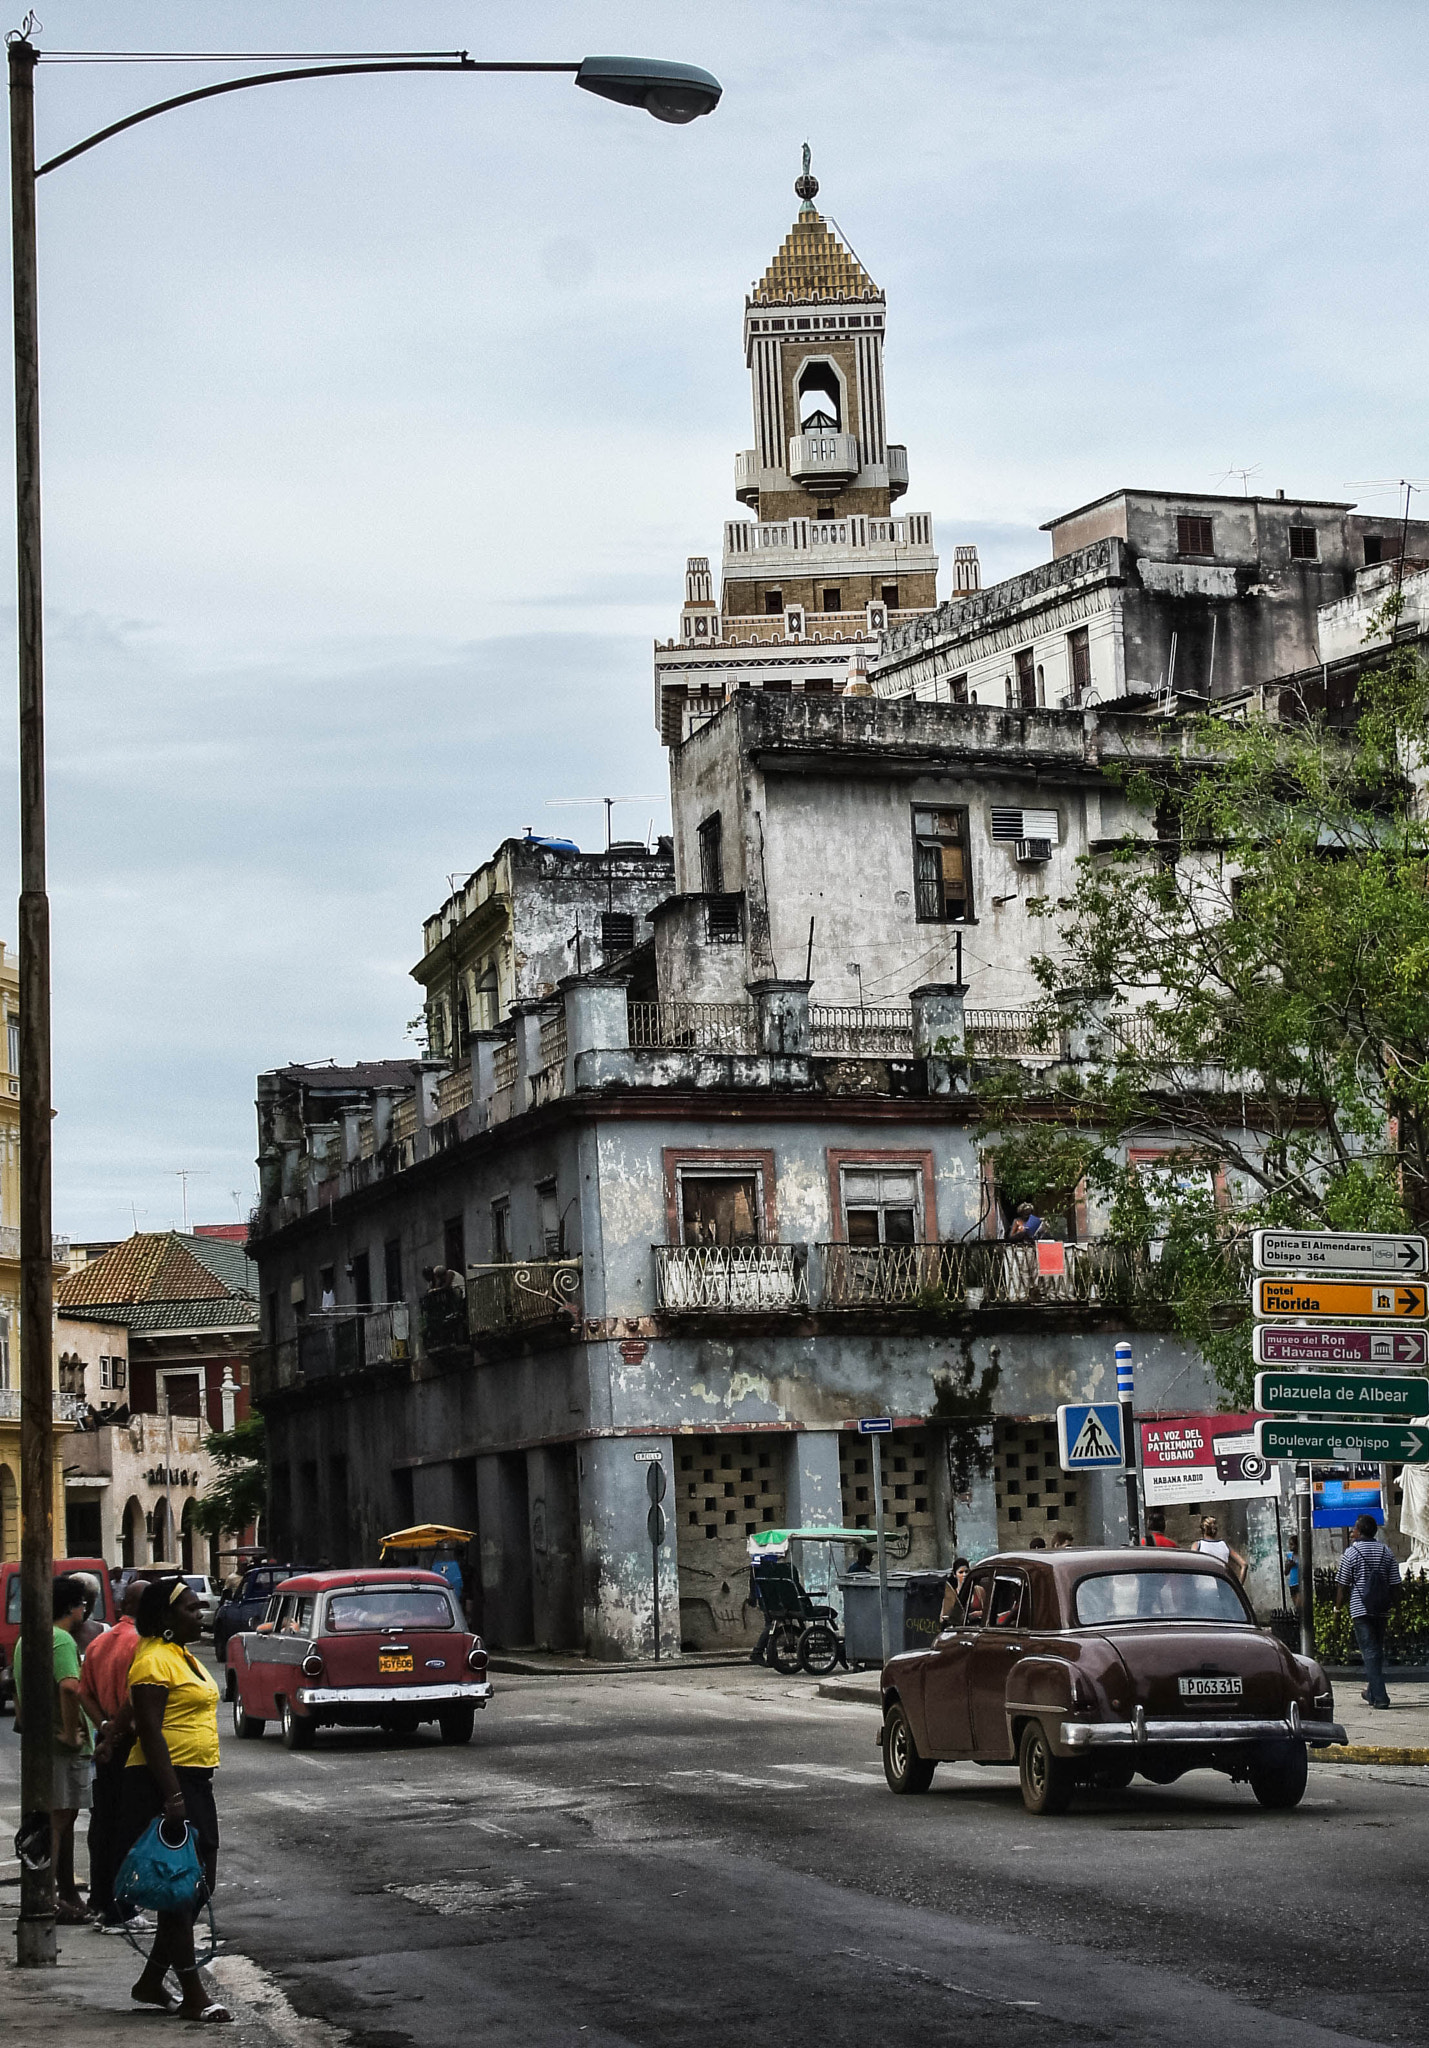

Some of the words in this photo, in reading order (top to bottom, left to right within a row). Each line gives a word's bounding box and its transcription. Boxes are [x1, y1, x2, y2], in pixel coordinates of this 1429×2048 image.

[1266, 1240, 1300, 1250] Optica
[1301, 1241, 1311, 1249] El
[1313, 1242, 1372, 1252] Almendares
[1266, 1252, 1301, 1262] Obispo
[1307, 1253, 1326, 1261] 364
[1266, 1286, 1294, 1295] hotel
[1266, 1297, 1320, 1310] Florida
[1267, 1336, 1300, 1344] museo
[1302, 1336, 1318, 1345] del
[1321, 1334, 1345, 1345] Ron
[1267, 1346, 1277, 1356] F.
[1281, 1346, 1329, 1358] Havana
[1333, 1348, 1362, 1359] Club
[1269, 1384, 1331, 1401] plazuela
[1335, 1387, 1354, 1400] de
[1359, 1388, 1408, 1402] Albear
[1148, 1432, 1159, 1442] LA
[1163, 1431, 1180, 1440] VOZ
[1185, 1429, 1202, 1438] DEL
[1147, 1439, 1204, 1452] PATRIMONIO
[1269, 1434, 1323, 1446] Boulevar
[1327, 1436, 1342, 1447] de
[1345, 1436, 1389, 1450] Obispo
[1159, 1450, 1194, 1461] CUBANO
[1153, 1476, 1181, 1485] HABANA
[1183, 1474, 1203, 1482] RADIO
